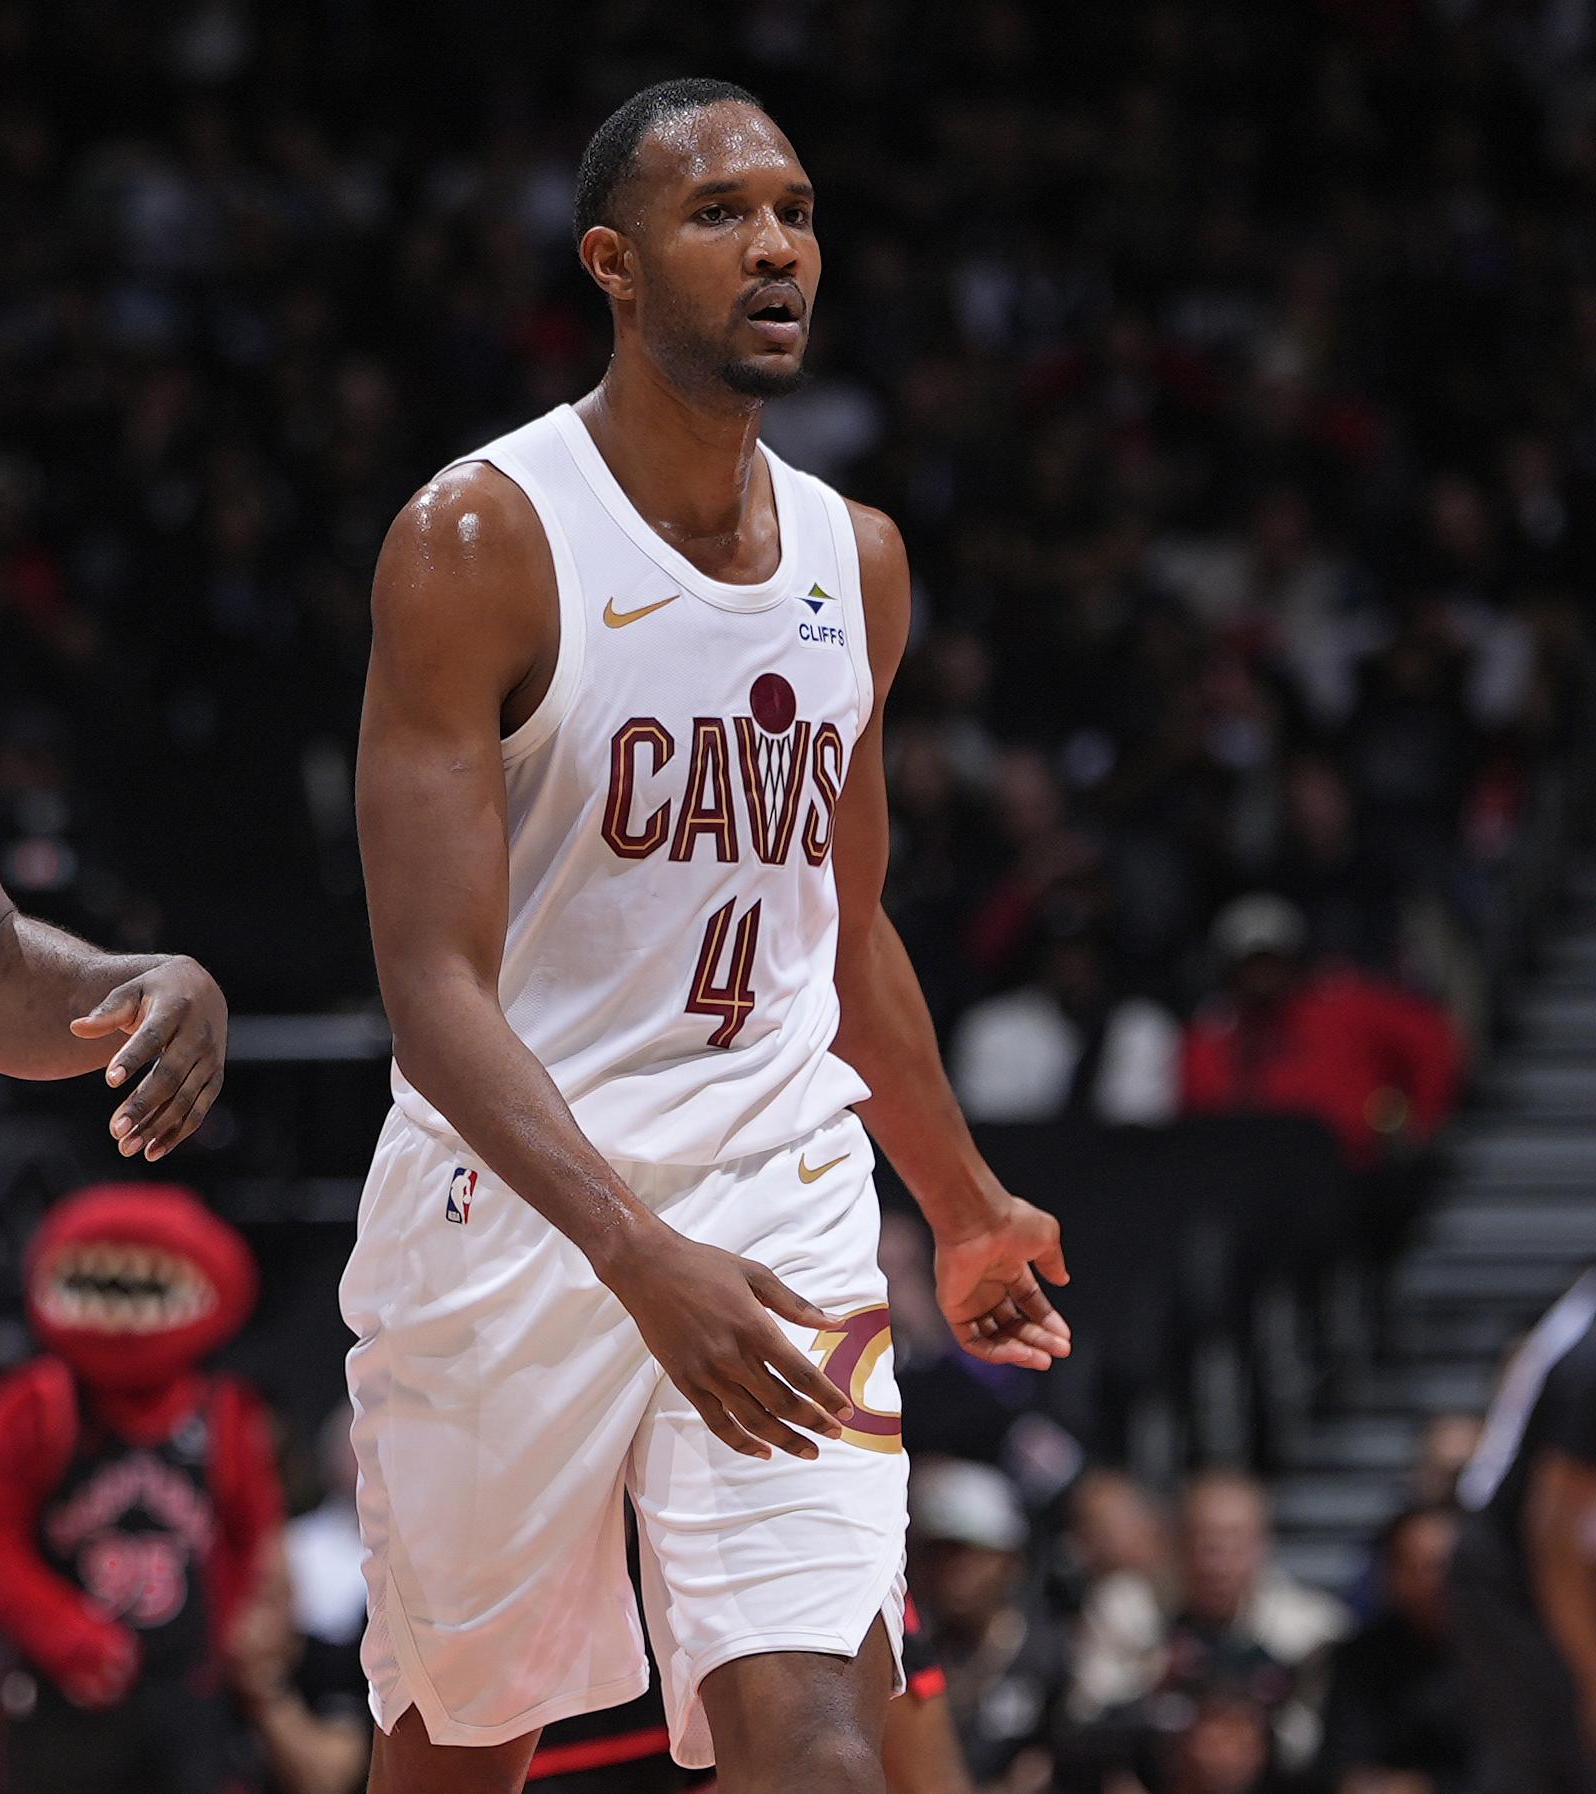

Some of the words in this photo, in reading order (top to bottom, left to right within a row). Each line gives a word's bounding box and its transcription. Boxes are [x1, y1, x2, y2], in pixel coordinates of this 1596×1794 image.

[799, 622, 845, 647] CLIFFS
[601, 715, 844, 868] CAVS
[683, 895, 763, 1050] 4
